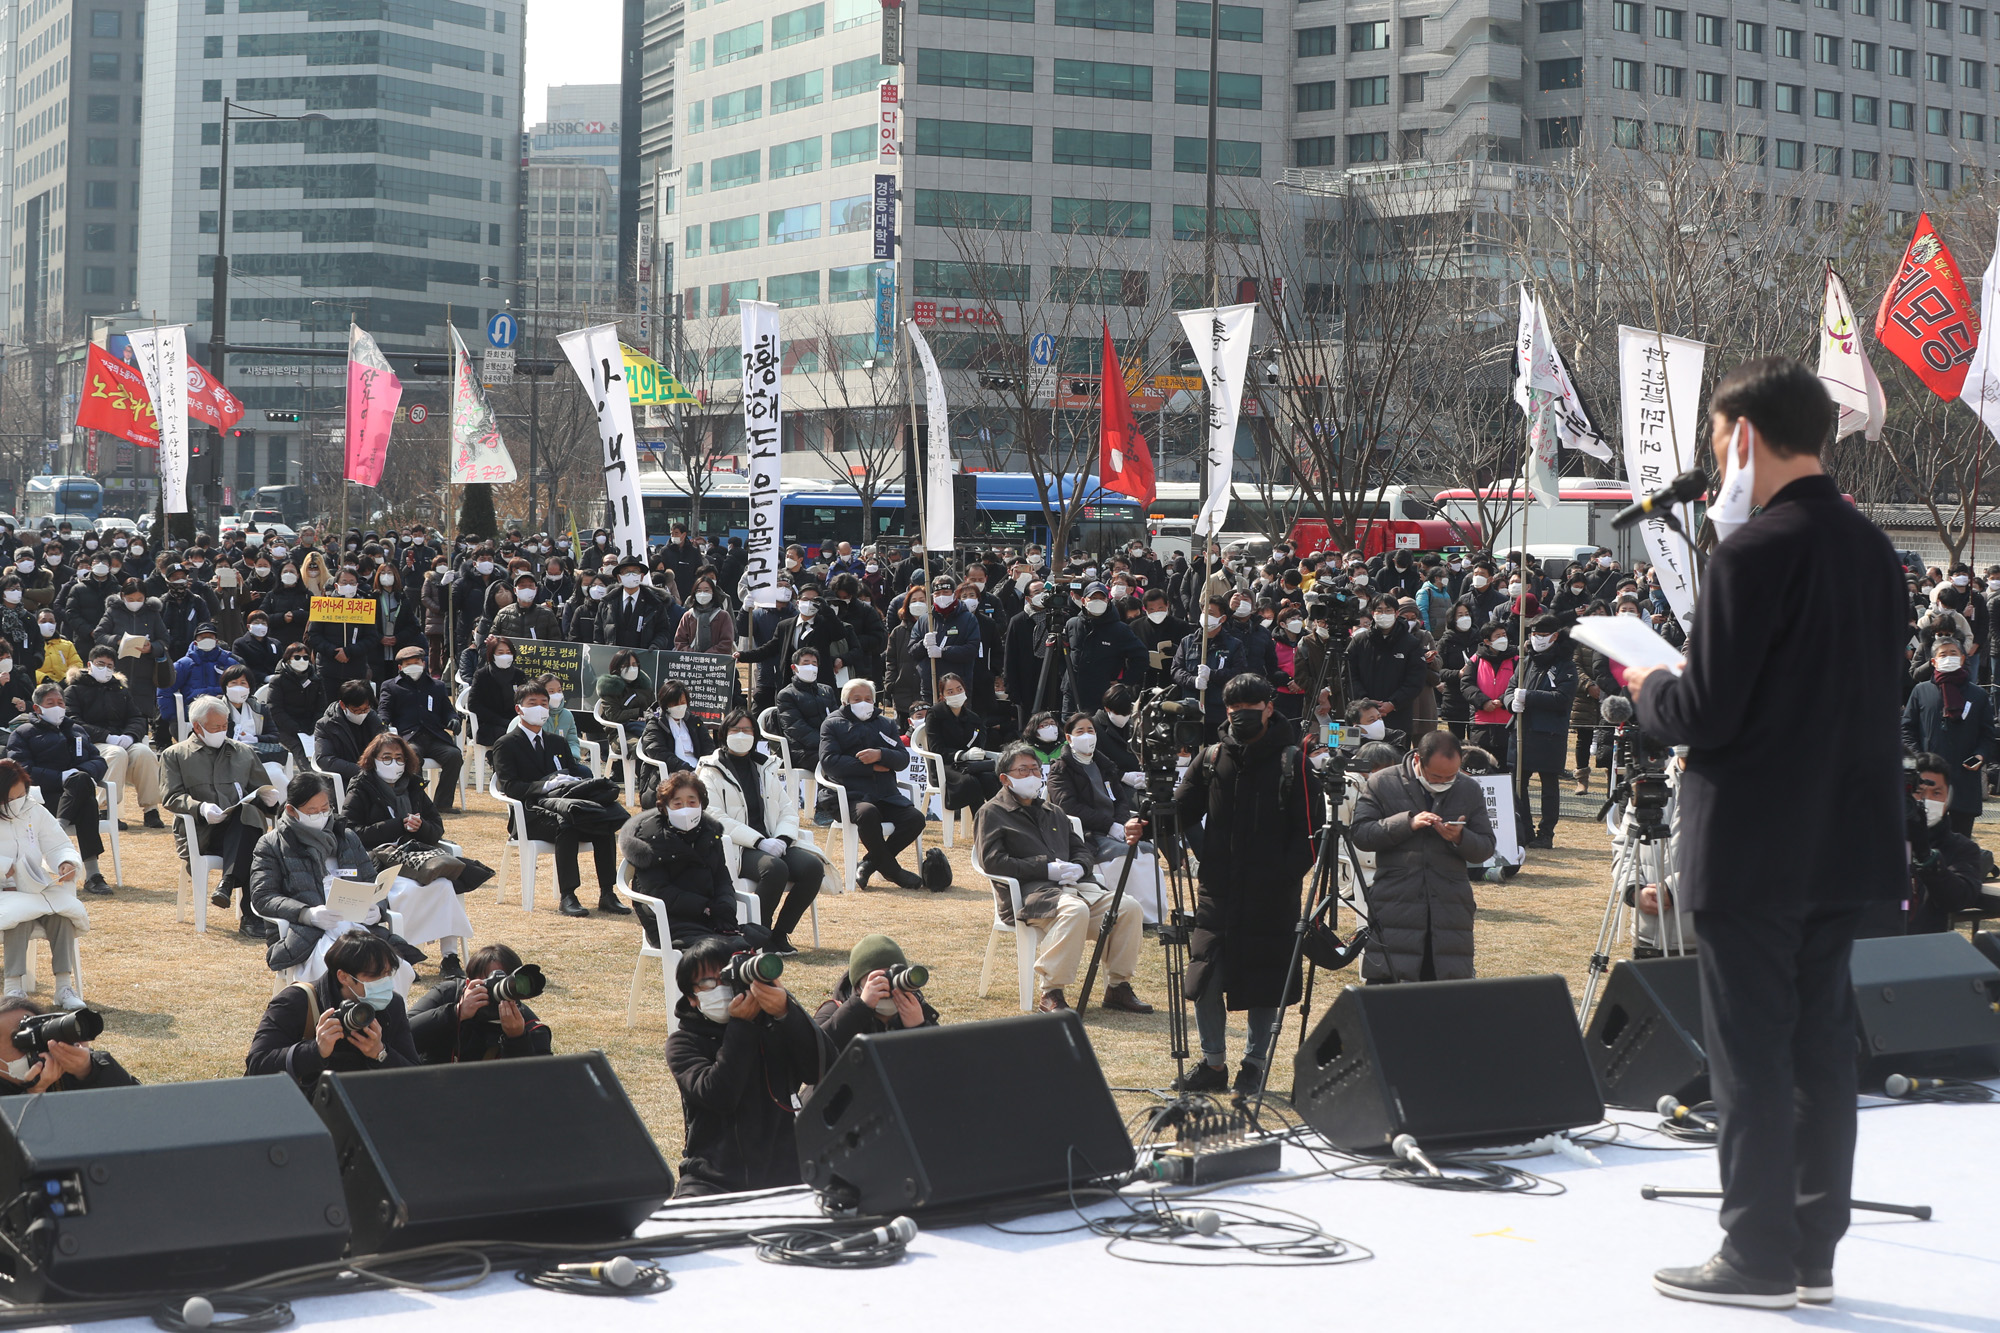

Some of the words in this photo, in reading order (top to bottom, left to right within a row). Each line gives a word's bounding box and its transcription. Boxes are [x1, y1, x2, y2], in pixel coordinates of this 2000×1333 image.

[547, 122, 584, 134] HSBC
[881, 111, 898, 155] 다이소
[875, 182, 888, 258] 경동대학교
[641, 224, 650, 256] 단월드
[941, 306, 1004, 325] 다이소
[486, 350, 514, 358] 좌회전시
[246, 365, 299, 376] 시청곧바른의원
[754, 335, 779, 459] 황해도
[412, 408, 425, 420] 50
[1397, 536, 1408, 544] NO
[310, 599, 344, 613] 깨어나서
[345, 600, 374, 615] 외쳐라
[539, 646, 557, 657] 평등
[559, 647, 578, 658] 평화
[911, 755, 918, 763] 딱
